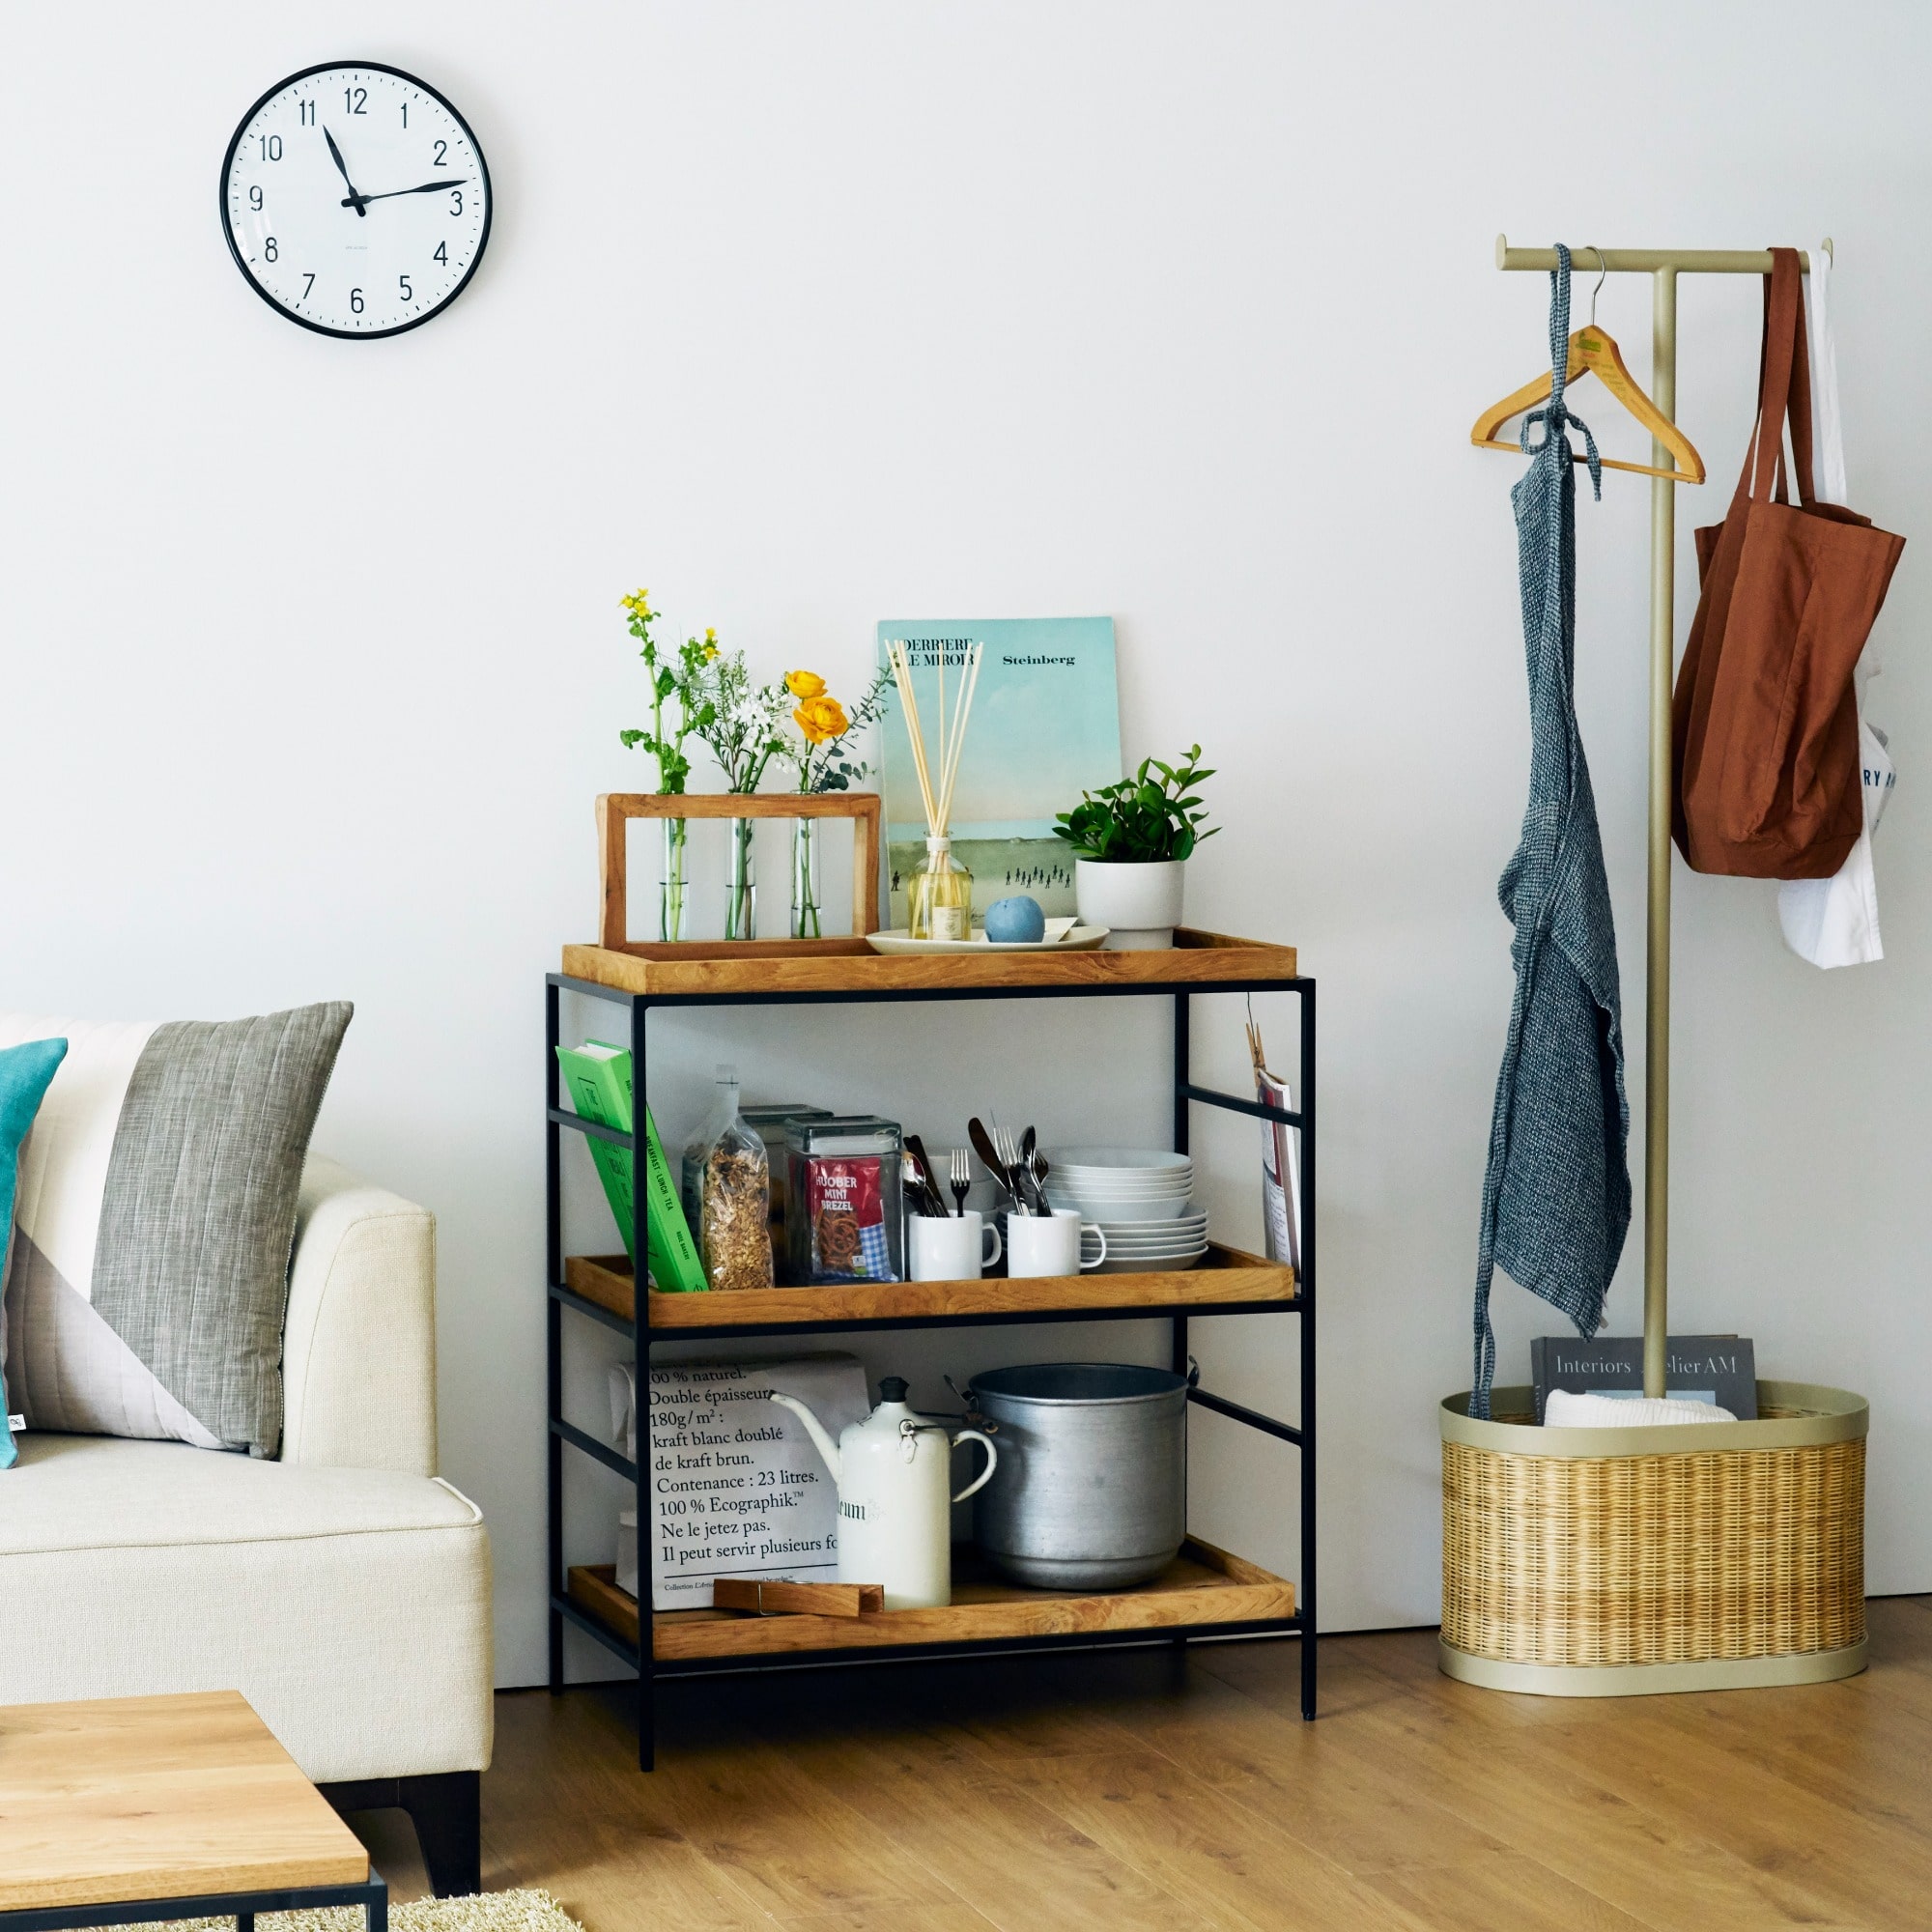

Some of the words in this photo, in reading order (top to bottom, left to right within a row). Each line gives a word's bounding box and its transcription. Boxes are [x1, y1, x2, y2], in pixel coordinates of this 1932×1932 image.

[298, 99, 315, 127] 11
[344, 88, 367, 114] 12
[400, 102, 407, 128] 1
[259, 134, 282, 161] 10
[433, 140, 447, 166] 2
[249, 185, 263, 212] 9
[449, 190, 463, 216] 3
[265, 237, 278, 263] 8
[433, 241, 448, 267] 4
[302, 273, 316, 299] 7
[400, 275, 412, 301] 5
[351, 288, 364, 314] 6
[1003, 655, 1075, 667] Steinberg
[656, 1173, 668, 1195] LUNCH
[664, 1198, 674, 1211] TEA
[816, 1176, 857, 1188] HUOBER
[824, 1189, 847, 1200] MINI
[821, 1200, 853, 1211] BREZEL
[649, 1373, 670, 1384] 00
[692, 1367, 747, 1381] naturel.
[1556, 1355, 1632, 1374] Interiors
[1641, 1355, 1701, 1374] elier
[1703, 1355, 1736, 1374] AM
[649, 1388, 700, 1406] Double
[704, 1388, 770, 1406] épaisseur
[652, 1433, 688, 1448] kraft
[693, 1430, 730, 1445] blanc
[735, 1427, 783, 1443] doublé
[655, 1456, 672, 1470] de
[677, 1453, 712, 1468] kraft
[717, 1451, 754, 1466] brun.
[657, 1477, 745, 1493] Contenance
[757, 1471, 776, 1486] 23
[780, 1468, 819, 1485] litres.
[660, 1501, 687, 1516] 100
[661, 1523, 683, 1539] Ne
[688, 1521, 700, 1536] le
[704, 1521, 739, 1540] jetez
[743, 1522, 771, 1538] pas.
[663, 1546, 675, 1562] Il
[680, 1548, 712, 1565] peut
[716, 1543, 755, 1557] servir
[760, 1539, 822, 1559] plusieurs
